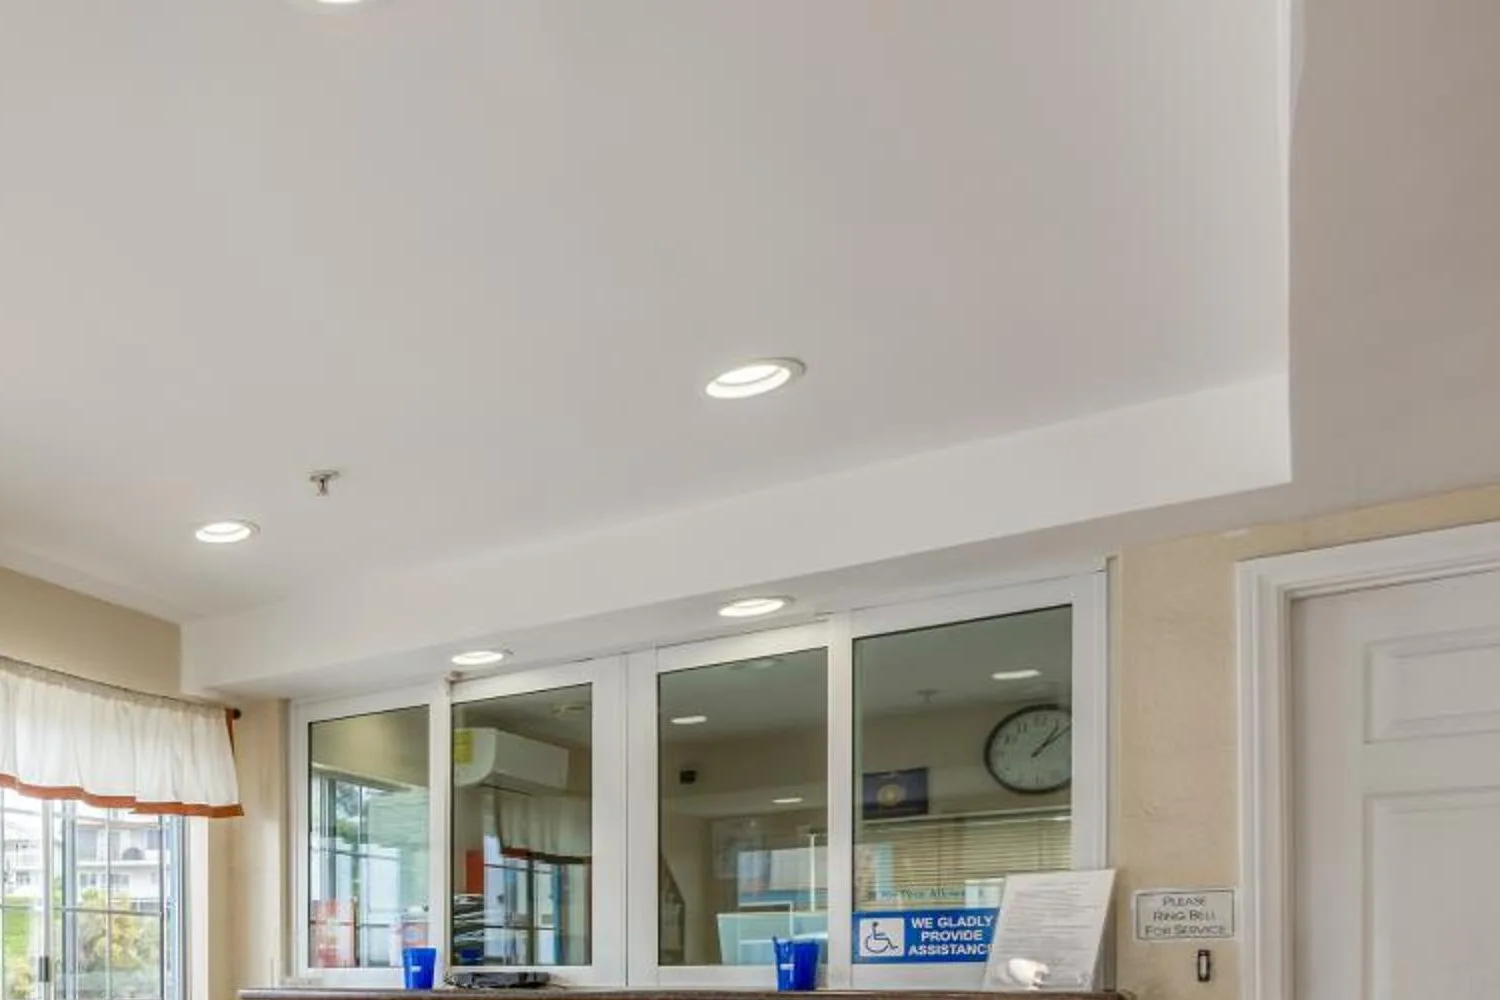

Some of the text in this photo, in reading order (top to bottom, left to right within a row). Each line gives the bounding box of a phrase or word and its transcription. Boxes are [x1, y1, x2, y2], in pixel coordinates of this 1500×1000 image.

[1163, 896, 1206, 907] PLEASE
[1153, 911, 1187, 921] RING
[911, 916, 995, 929] WE GLADLY
[1174, 924, 1227, 935] SERVICE
[921, 930, 983, 942] PROVIDE
